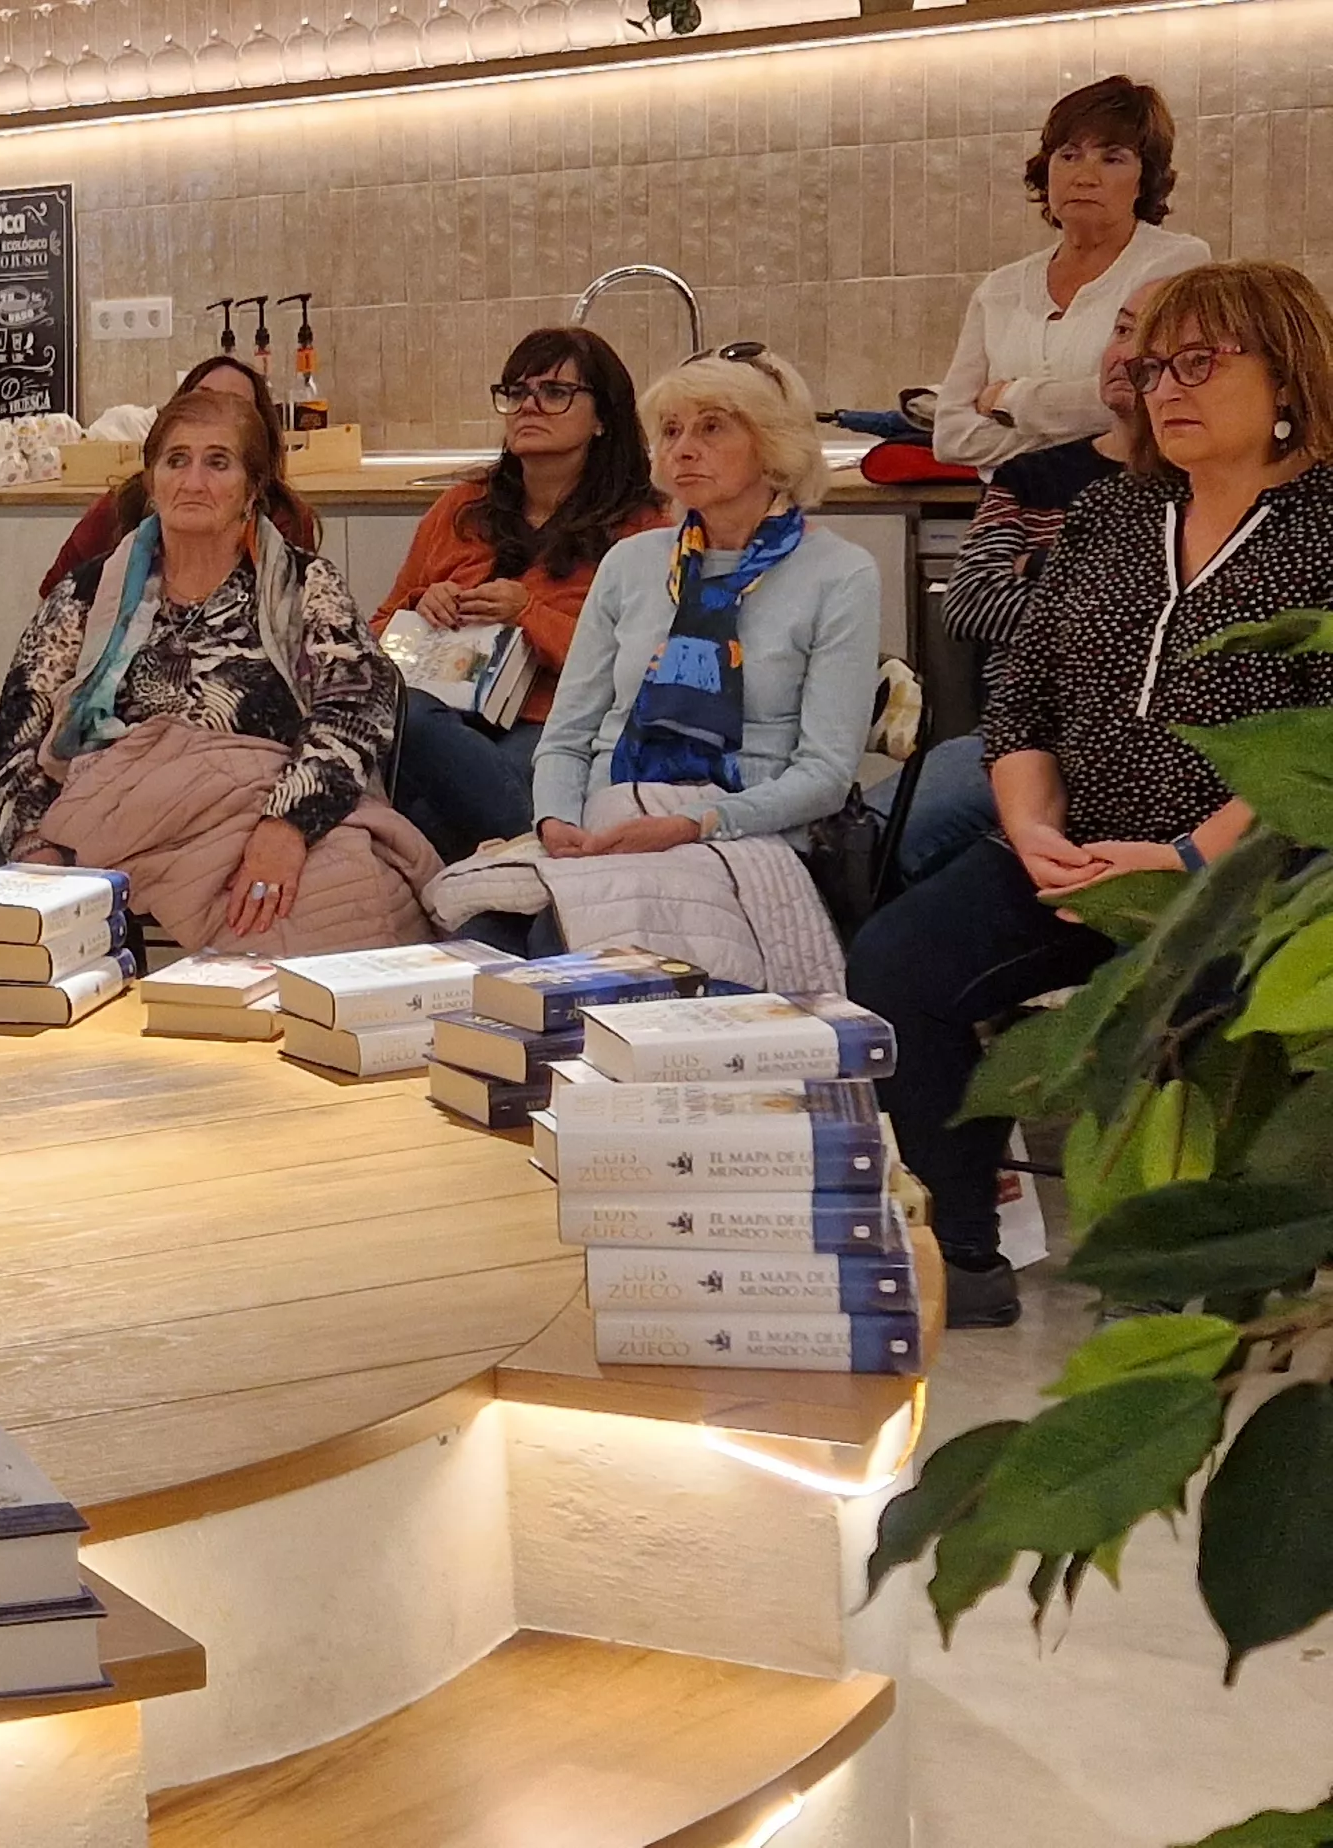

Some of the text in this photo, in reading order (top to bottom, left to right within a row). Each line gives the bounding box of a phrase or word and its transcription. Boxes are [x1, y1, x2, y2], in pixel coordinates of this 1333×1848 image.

[11, 251, 48, 269] JUSTO
[663, 1054, 700, 1068] LUIS
[772, 1050, 808, 1061] MAPA
[810, 1049, 826, 1060] DE
[757, 1061, 805, 1073] MUNDO
[651, 1069, 711, 1082] ZUECO
[593, 1149, 638, 1164] LUIS
[709, 1152, 724, 1164] EL
[729, 1151, 773, 1163] MAPA
[777, 1151, 795, 1163] DE
[578, 1166, 652, 1182] ZUECO
[707, 1165, 813, 1177] MUNDO NUEV
[593, 1210, 638, 1222] LUIS
[709, 1213, 724, 1225] EL
[729, 1214, 773, 1225] MAPA
[777, 1214, 795, 1226] DE
[581, 1225, 653, 1239] ZUECO
[707, 1228, 813, 1240] MUNDO NUEV
[623, 1266, 668, 1281] LUIS
[740, 1271, 754, 1282] EL
[759, 1271, 802, 1283] MAPA
[807, 1271, 824, 1283] DE
[608, 1284, 682, 1299] ZUECO
[738, 1285, 799, 1297] MUNDO
[631, 1325, 676, 1339] LUIS
[748, 1330, 761, 1342] EL
[767, 1331, 810, 1343] MAPA
[815, 1332, 833, 1344] DE
[617, 1341, 691, 1356] ZUECO
[747, 1345, 851, 1357] MUNDO NUEV
